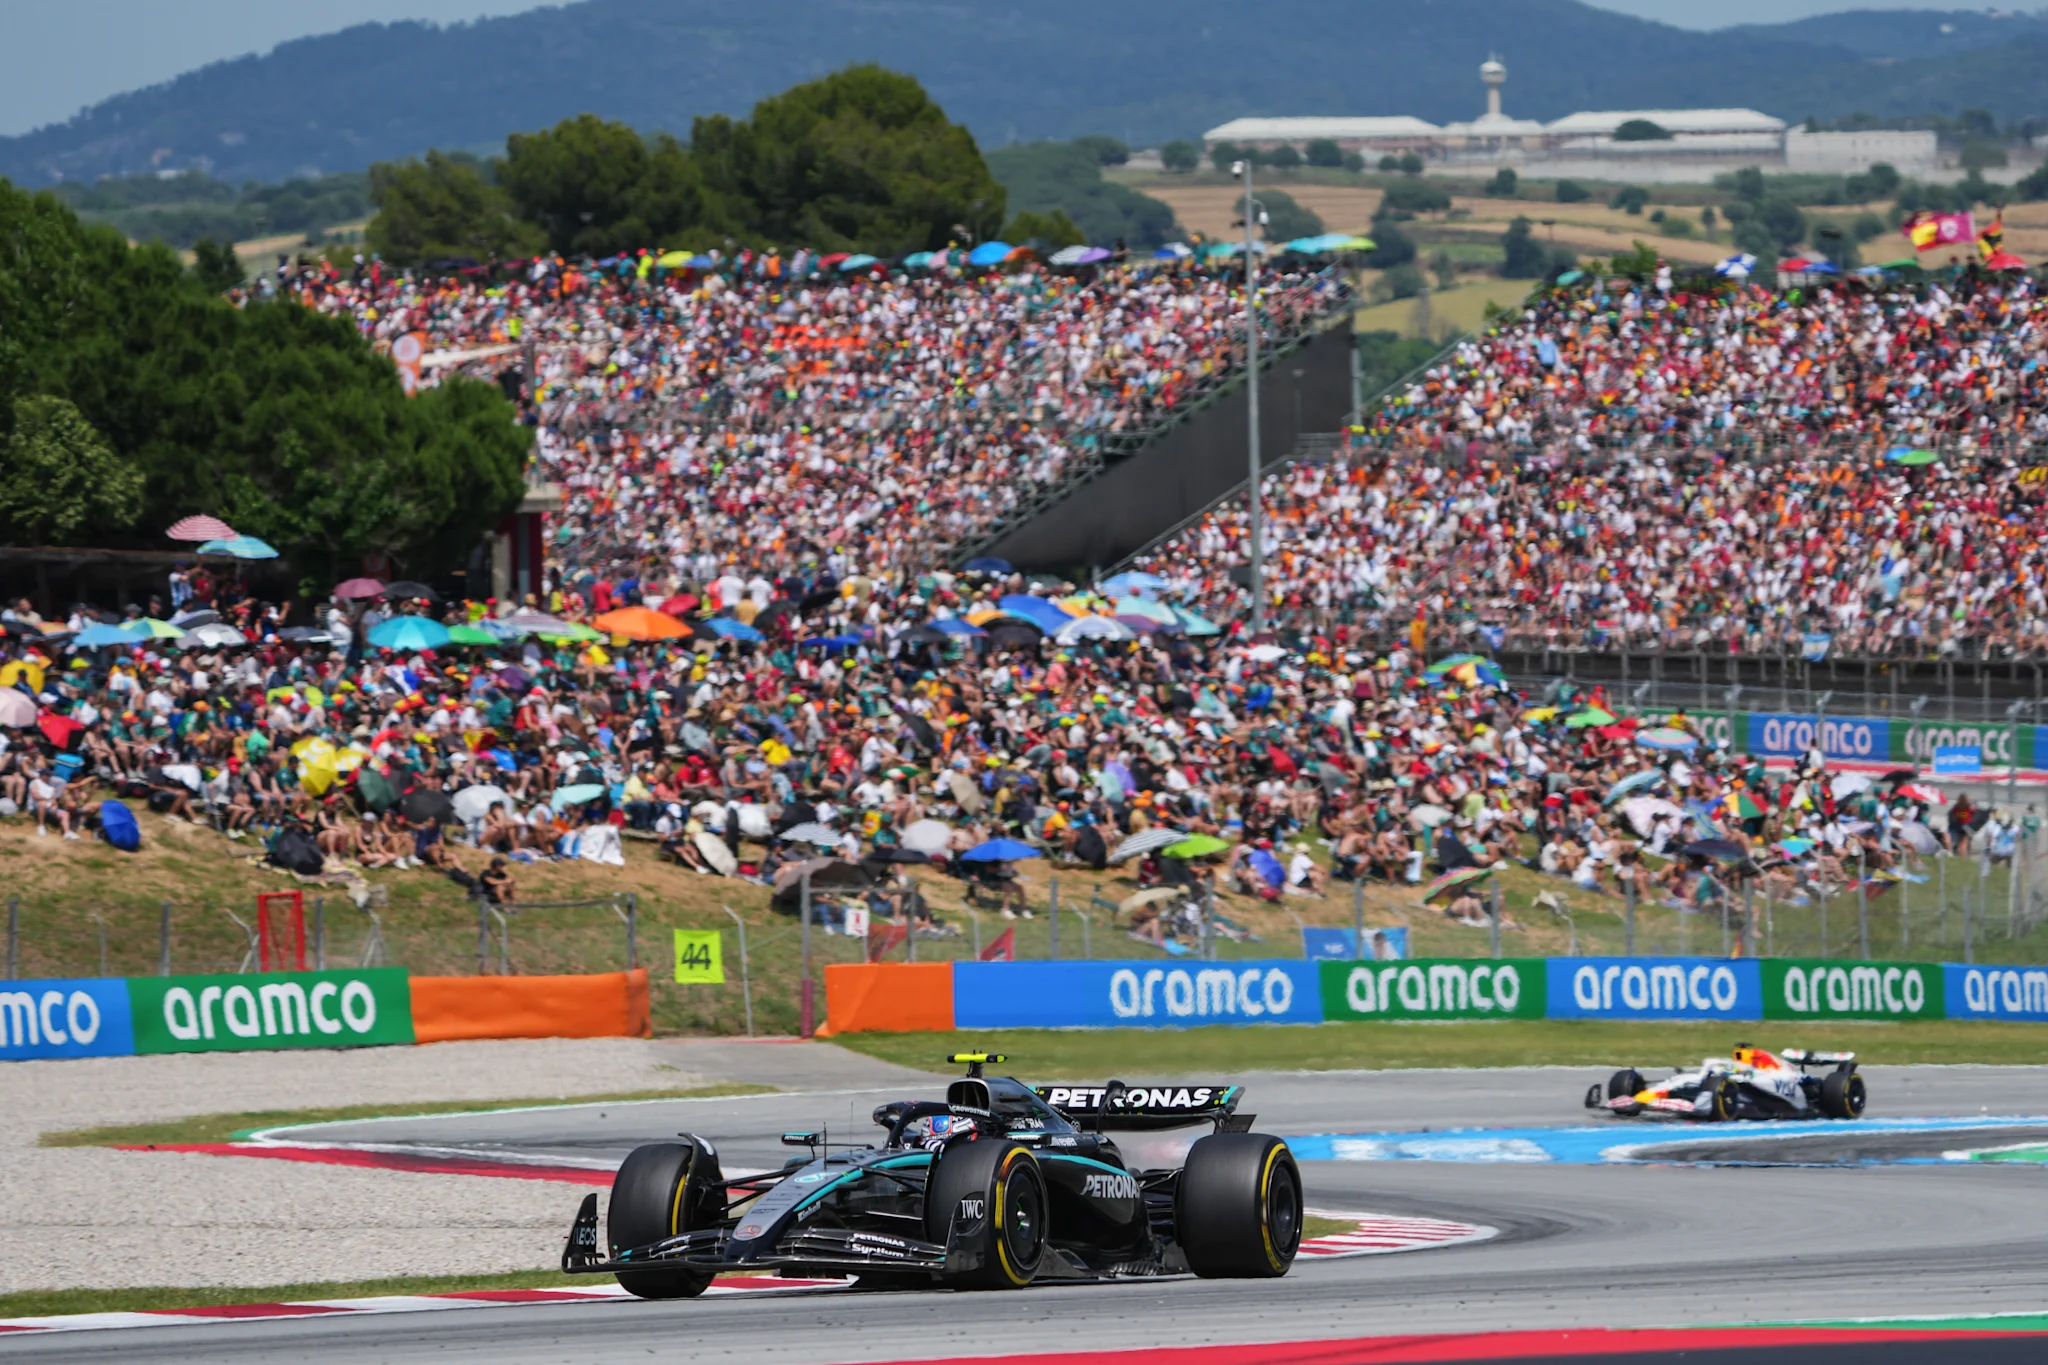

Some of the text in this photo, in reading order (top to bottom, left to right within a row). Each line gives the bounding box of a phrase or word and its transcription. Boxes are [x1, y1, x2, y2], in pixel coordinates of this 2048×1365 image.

[1763, 718, 1873, 755] aramco
[681, 943, 712, 970] 44
[163, 980, 377, 1040] aramco
[1109, 968, 1293, 1017] aramco
[1346, 964, 1521, 1013] aramco
[1573, 965, 1738, 1010] aramco
[1784, 966, 1925, 1013] aramco
[961, 1199, 984, 1219] IWC
[853, 1232, 906, 1247] PETRONAS
